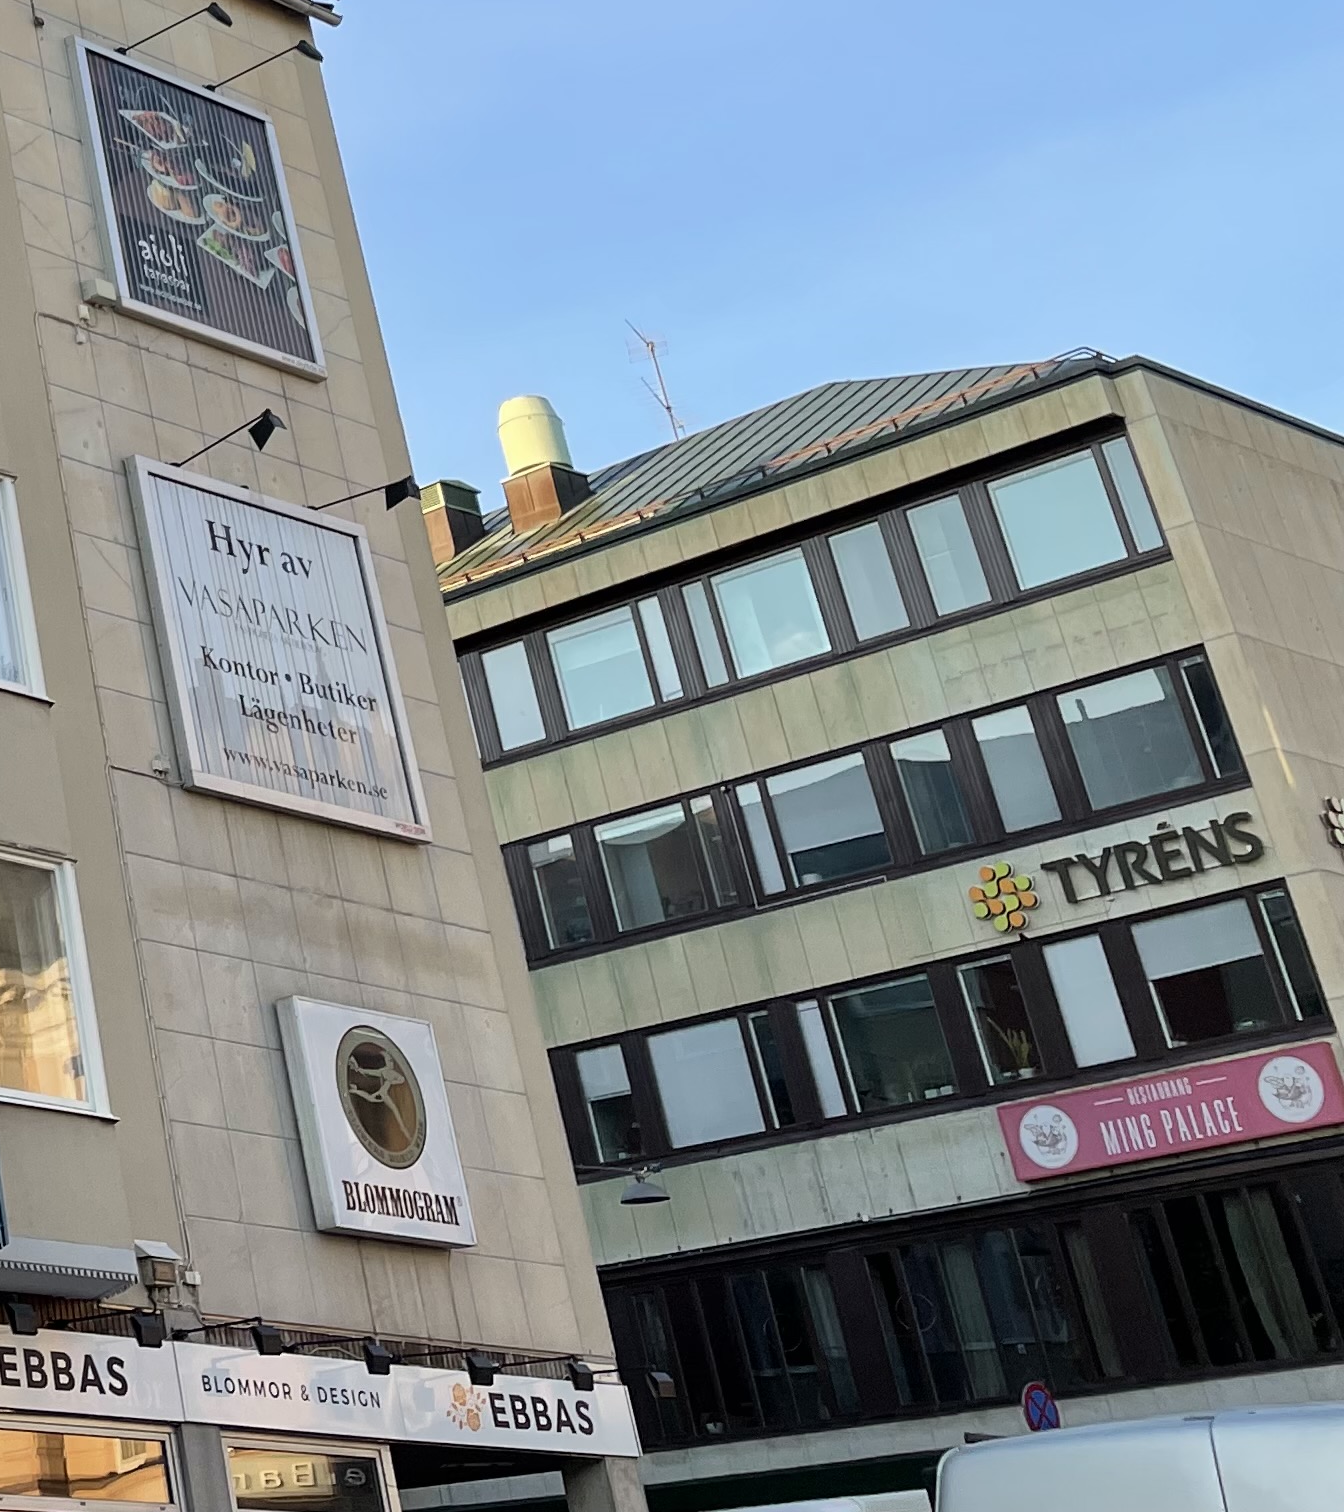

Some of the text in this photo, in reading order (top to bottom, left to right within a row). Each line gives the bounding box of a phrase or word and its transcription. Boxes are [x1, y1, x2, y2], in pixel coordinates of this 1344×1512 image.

[205, 520, 313, 579] Hyr av
[178, 576, 368, 655] VASAPARKEN
[200, 645, 377, 713] Kontor Butiker
[238, 693, 358, 746] Lägenheter
[223, 746, 389, 801] www.vasaparken.se
[1040, 811, 1264, 904] TYRÉNS
[1126, 1077, 1193, 1106] RESTAURANG
[1100, 1096, 1244, 1155] MING PALACE
[201, 1374, 381, 1409] BLOMMOR & DESIGN
[489, 1392, 594, 1436] EBBAS
